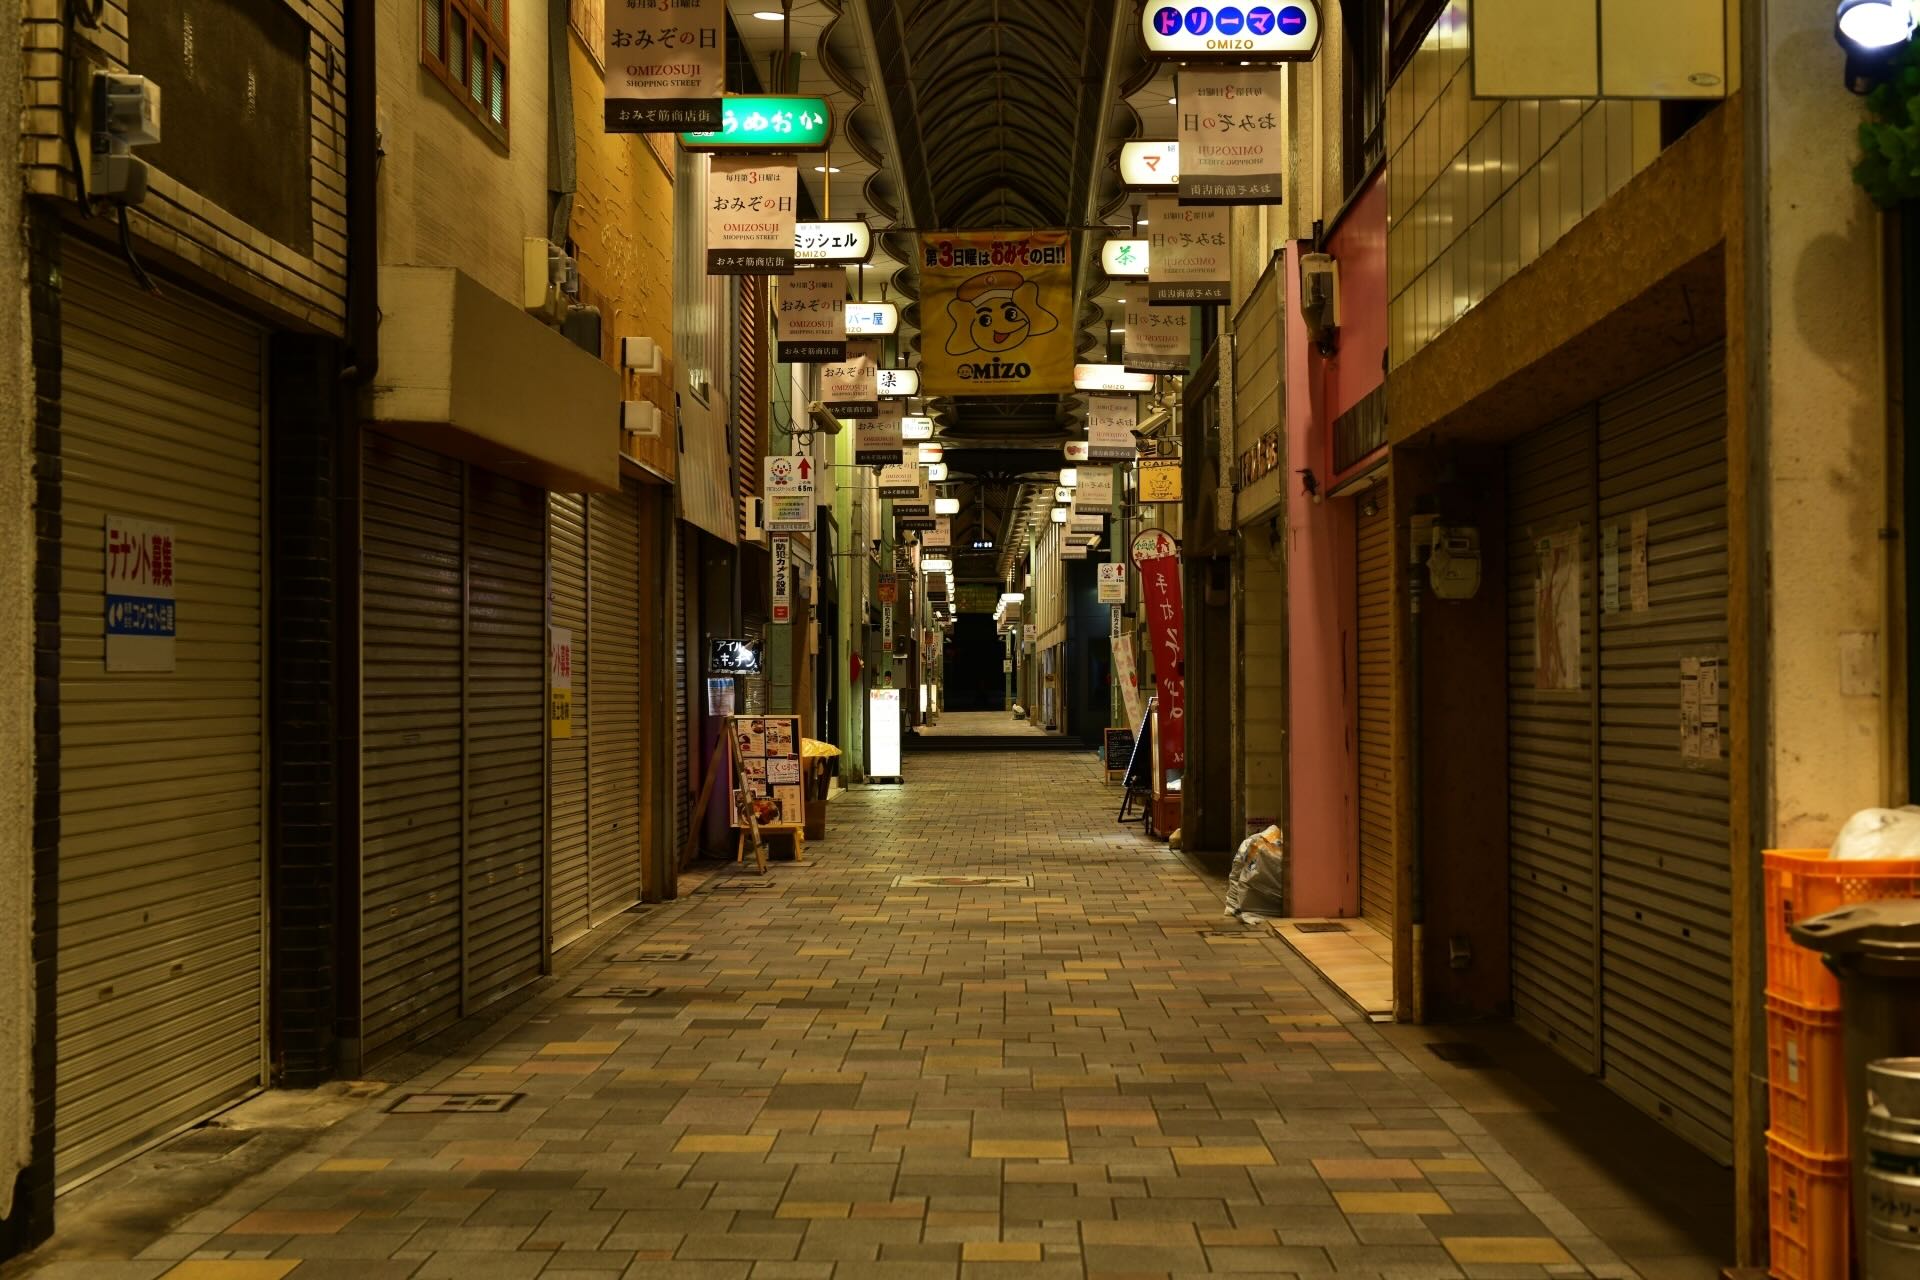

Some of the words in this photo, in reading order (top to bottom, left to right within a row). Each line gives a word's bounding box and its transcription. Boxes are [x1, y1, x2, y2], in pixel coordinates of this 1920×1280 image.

[1159, 9, 1302, 35] ドリーマー
[611, 27, 716, 50] おみぞの日
[1206, 39, 1254, 49] OMIZO
[626, 64, 701, 77] OMIZOSUJI
[626, 79, 669, 88] SHOPPING
[670, 79, 702, 87] STREET
[619, 109, 710, 122] おみぞ筋商店街
[727, 172, 780, 184] 毎月第3日曜は
[714, 196, 791, 212] おみぞの日
[724, 224, 779, 234] OMIZOSUJI
[794, 233, 858, 249] ミッシェル
[795, 250, 827, 258] OMIZO
[717, 256, 785, 267] おみぞ筋商店街
[781, 299, 843, 313] おみぞの日
[789, 320, 834, 329] OMIZOSUJI
[824, 366, 875, 378] おみぞの日
[109, 529, 172, 587] テナント募集
[775, 543, 786, 596] 防犯カメラ設置
